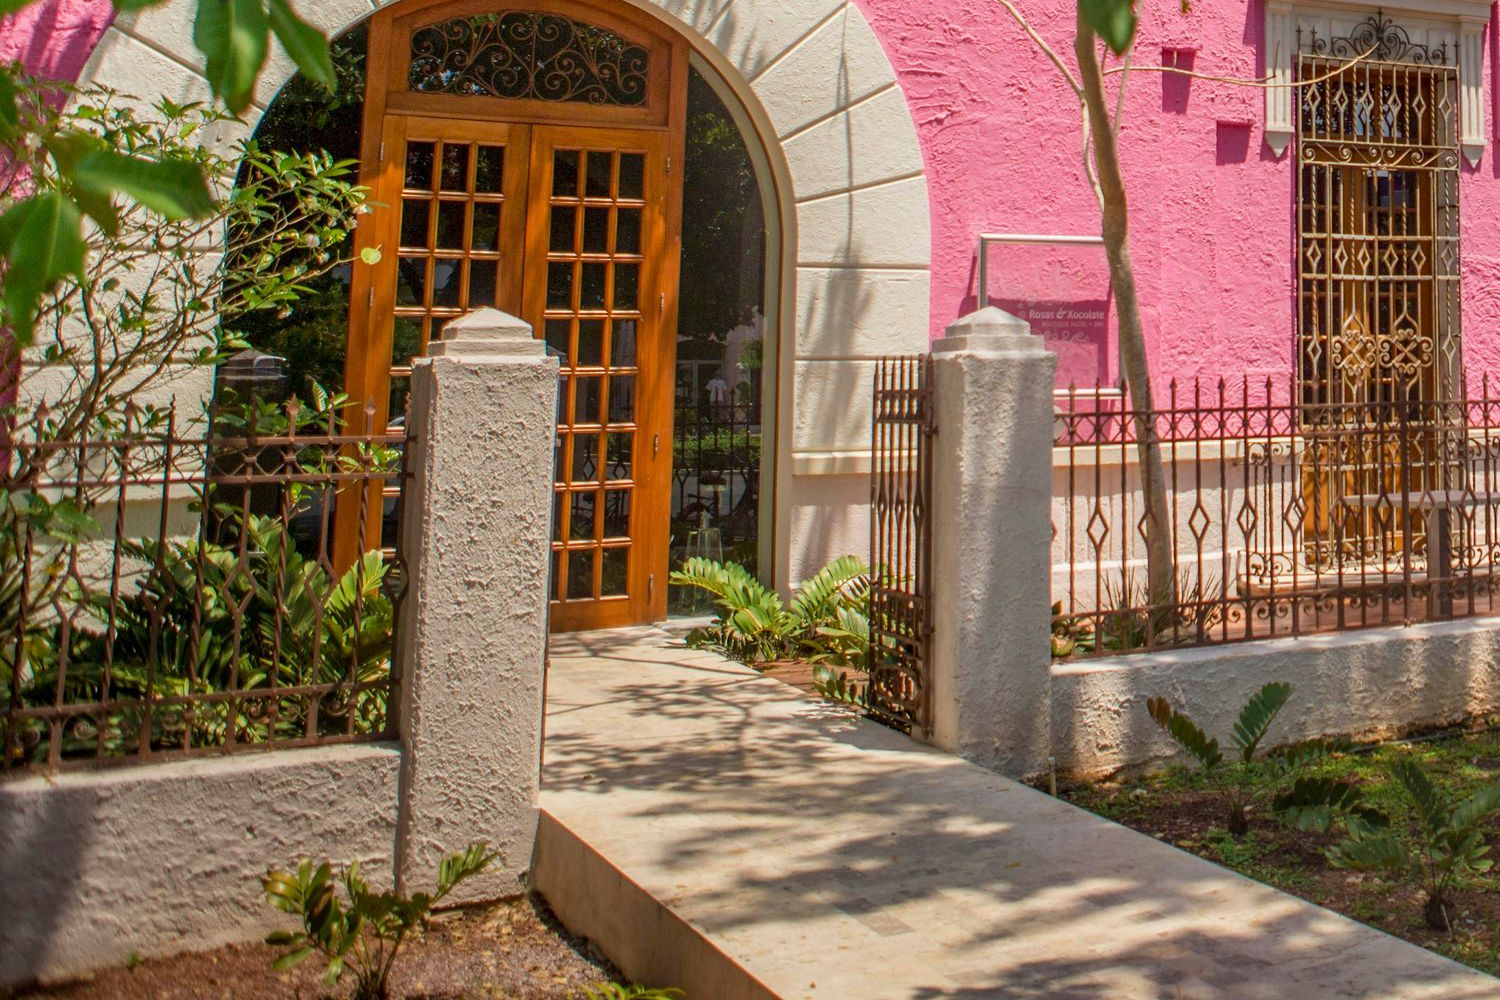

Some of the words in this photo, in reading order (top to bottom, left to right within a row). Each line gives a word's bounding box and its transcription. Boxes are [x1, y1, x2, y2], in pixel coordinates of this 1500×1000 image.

[1029, 309, 1055, 320] Rosas
[1056, 307, 1067, 320] &
[1067, 310, 1105, 320] Xocolate
